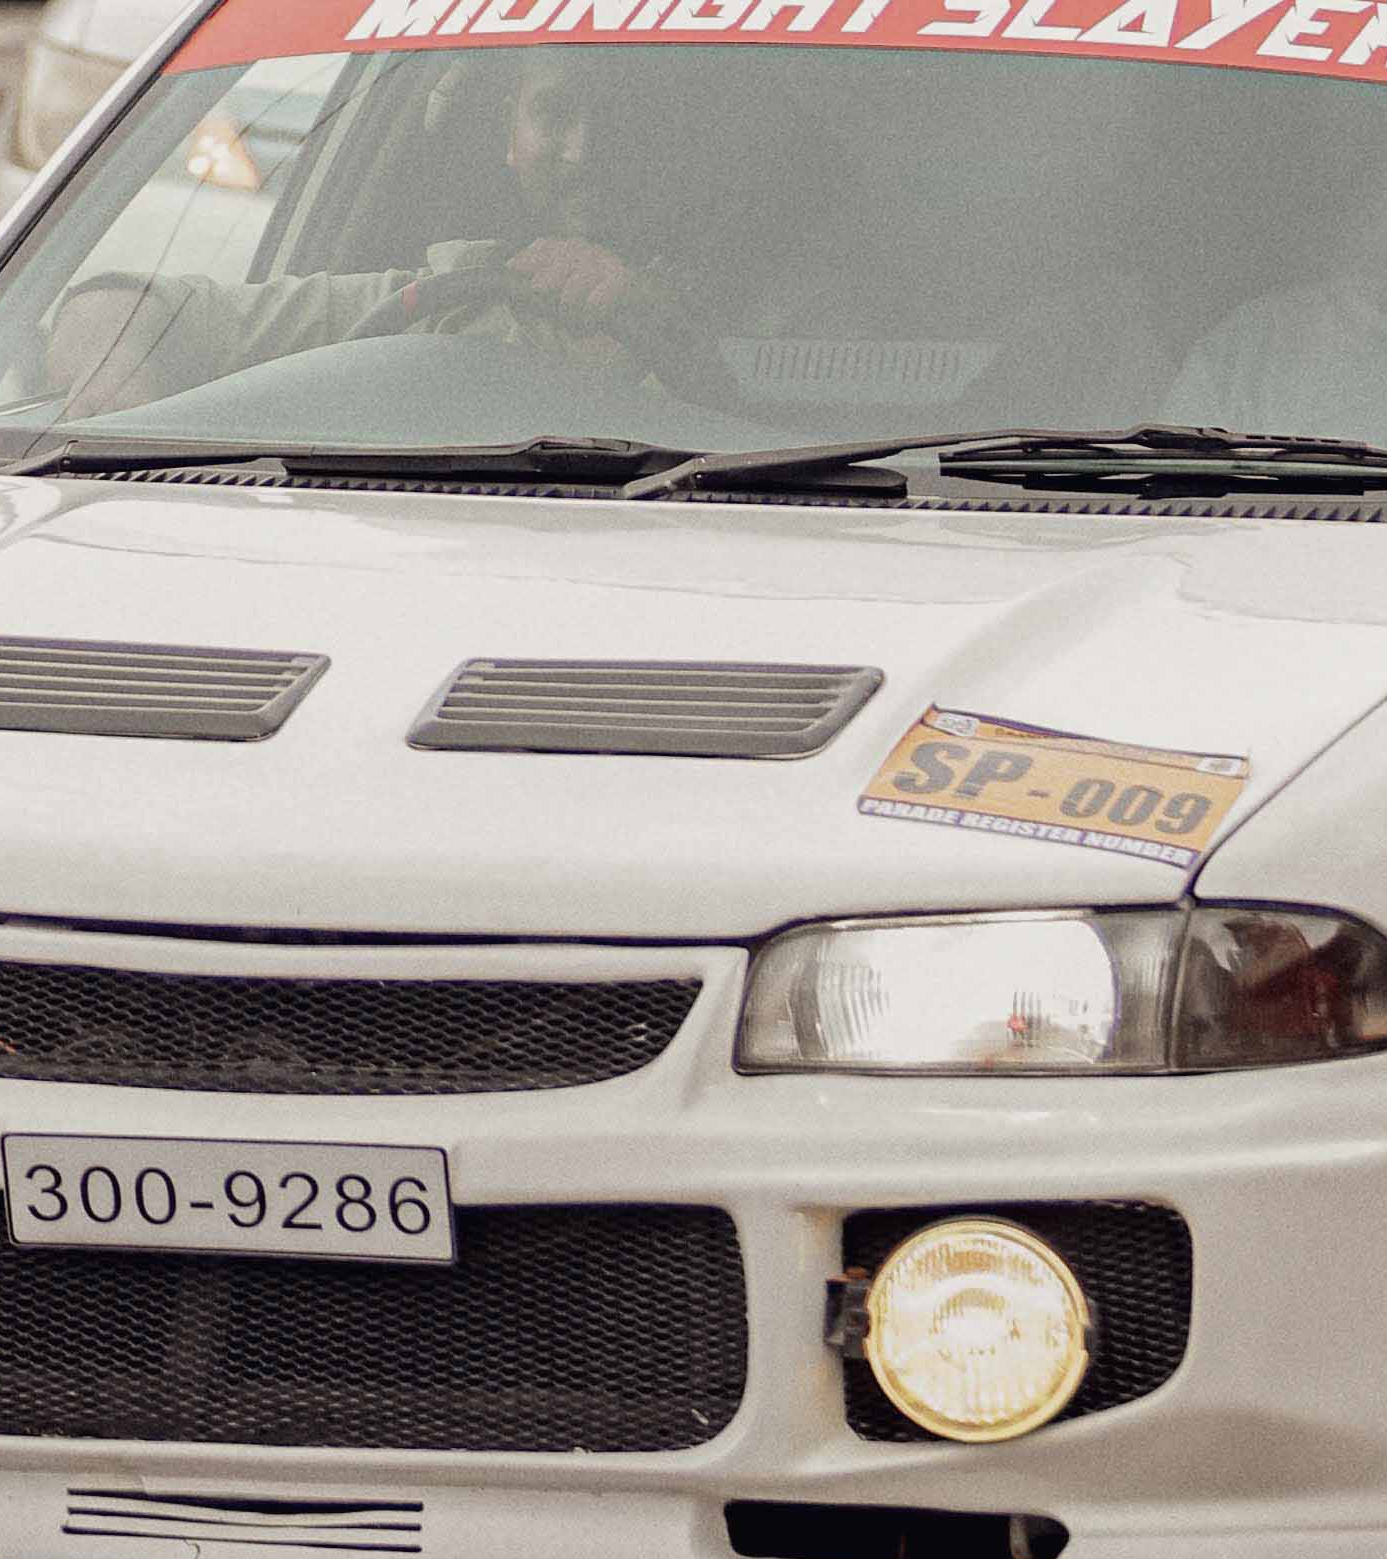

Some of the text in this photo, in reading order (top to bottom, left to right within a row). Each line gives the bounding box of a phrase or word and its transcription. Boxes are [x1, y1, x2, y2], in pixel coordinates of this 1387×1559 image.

[860, 799, 1195, 867] PARADE REGISTER NUMBER
[25, 1164, 431, 1234] 300-9286
